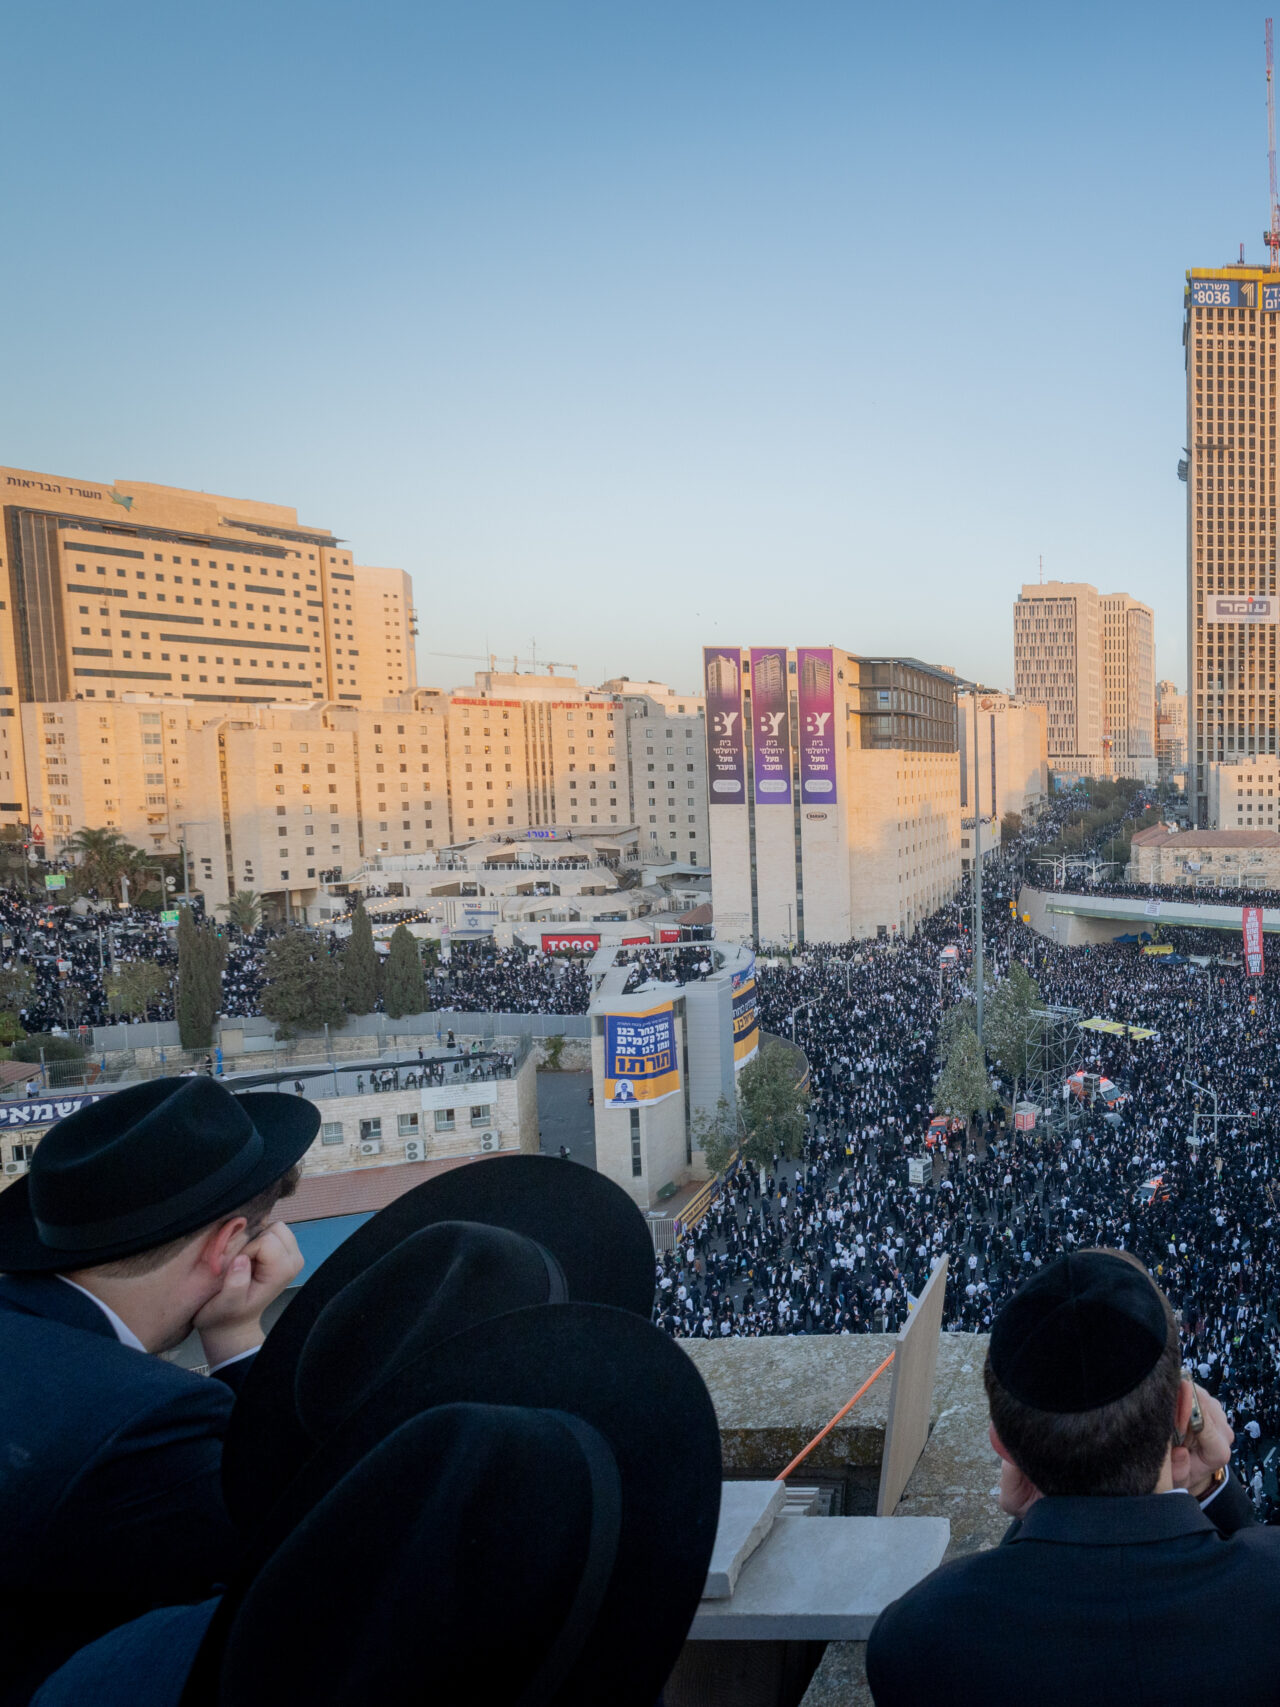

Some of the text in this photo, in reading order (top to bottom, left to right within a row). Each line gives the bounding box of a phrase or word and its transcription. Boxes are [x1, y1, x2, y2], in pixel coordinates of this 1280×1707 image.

[1194, 282, 1230, 290] משרדים
[6, 476, 102, 500] משרד הבריאות
[1220, 603, 1266, 612] עומר
[714, 712, 739, 736] BY
[760, 712, 786, 736] BY
[806, 712, 832, 736] BY
[548, 940, 594, 951] TOGO
[617, 1022, 669, 1036] אשר בחר בנו
[617, 1030, 669, 1046] מכל העמים
[616, 1040, 670, 1055] ונתן לנו את
[617, 1052, 670, 1072] תורתו
